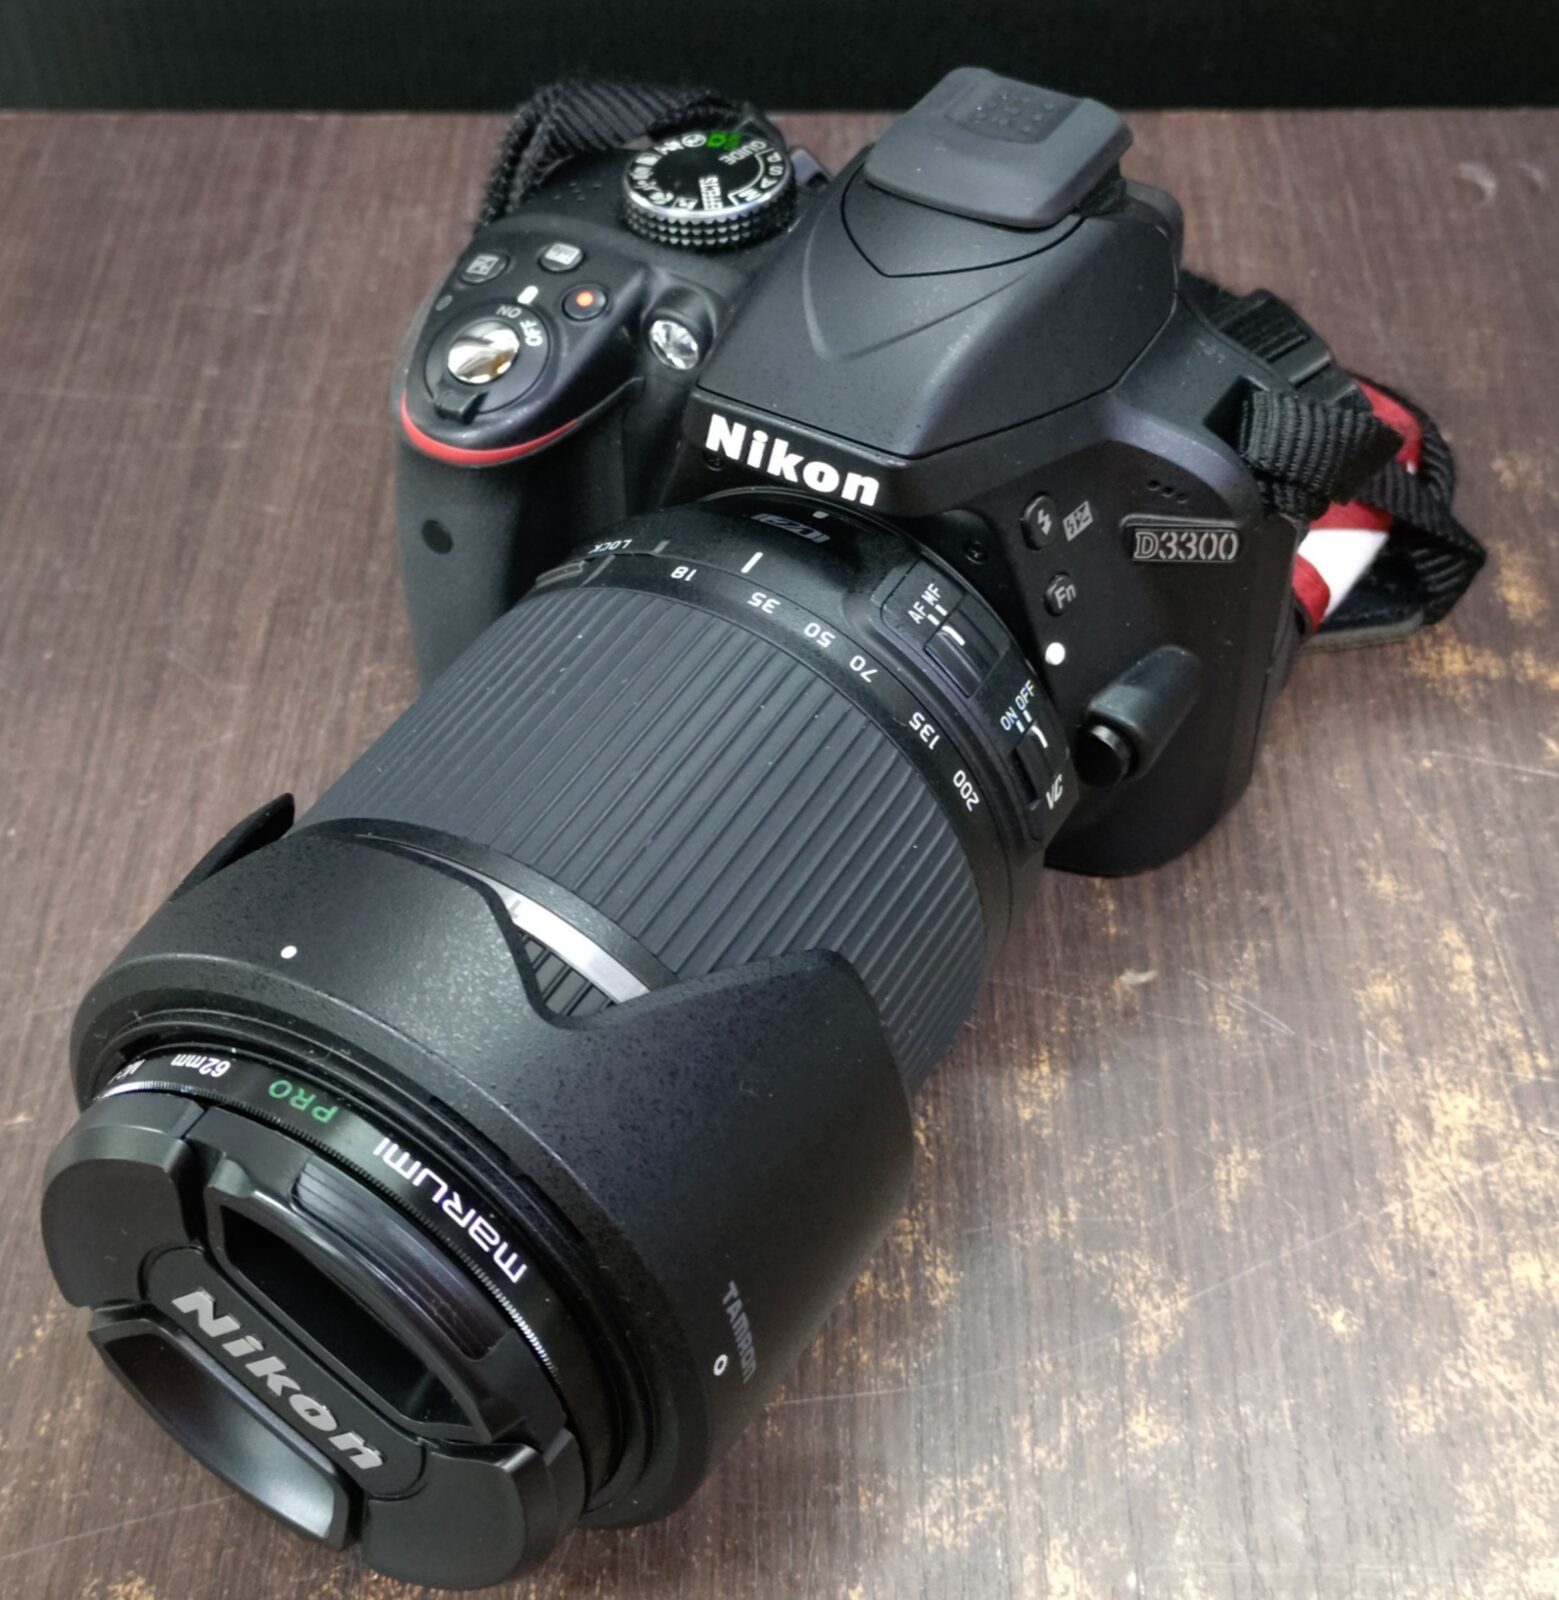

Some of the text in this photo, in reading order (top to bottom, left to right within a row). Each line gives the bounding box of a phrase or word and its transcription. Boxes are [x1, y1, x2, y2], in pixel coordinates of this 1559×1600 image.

[718, 140, 767, 165] GUIDE
[699, 174, 723, 211] EFFECTS
[738, 152, 784, 201] P S A M
[495, 304, 523, 319] ON
[519, 319, 544, 347] OFF
[705, 413, 880, 507] Nikon
[588, 538, 633, 554] LOCK
[1133, 531, 1239, 560] D3300
[908, 583, 942, 625] AF MF
[1053, 584, 1077, 610] Fn
[670, 565, 980, 812] 18 35 50 70 135 200
[1000, 679, 1036, 732] ON OFF
[1046, 773, 1063, 811] VC
[171, 1053, 231, 1078] 62mm
[268, 1079, 339, 1124] PRO
[171, 1287, 384, 1470] Nikon
